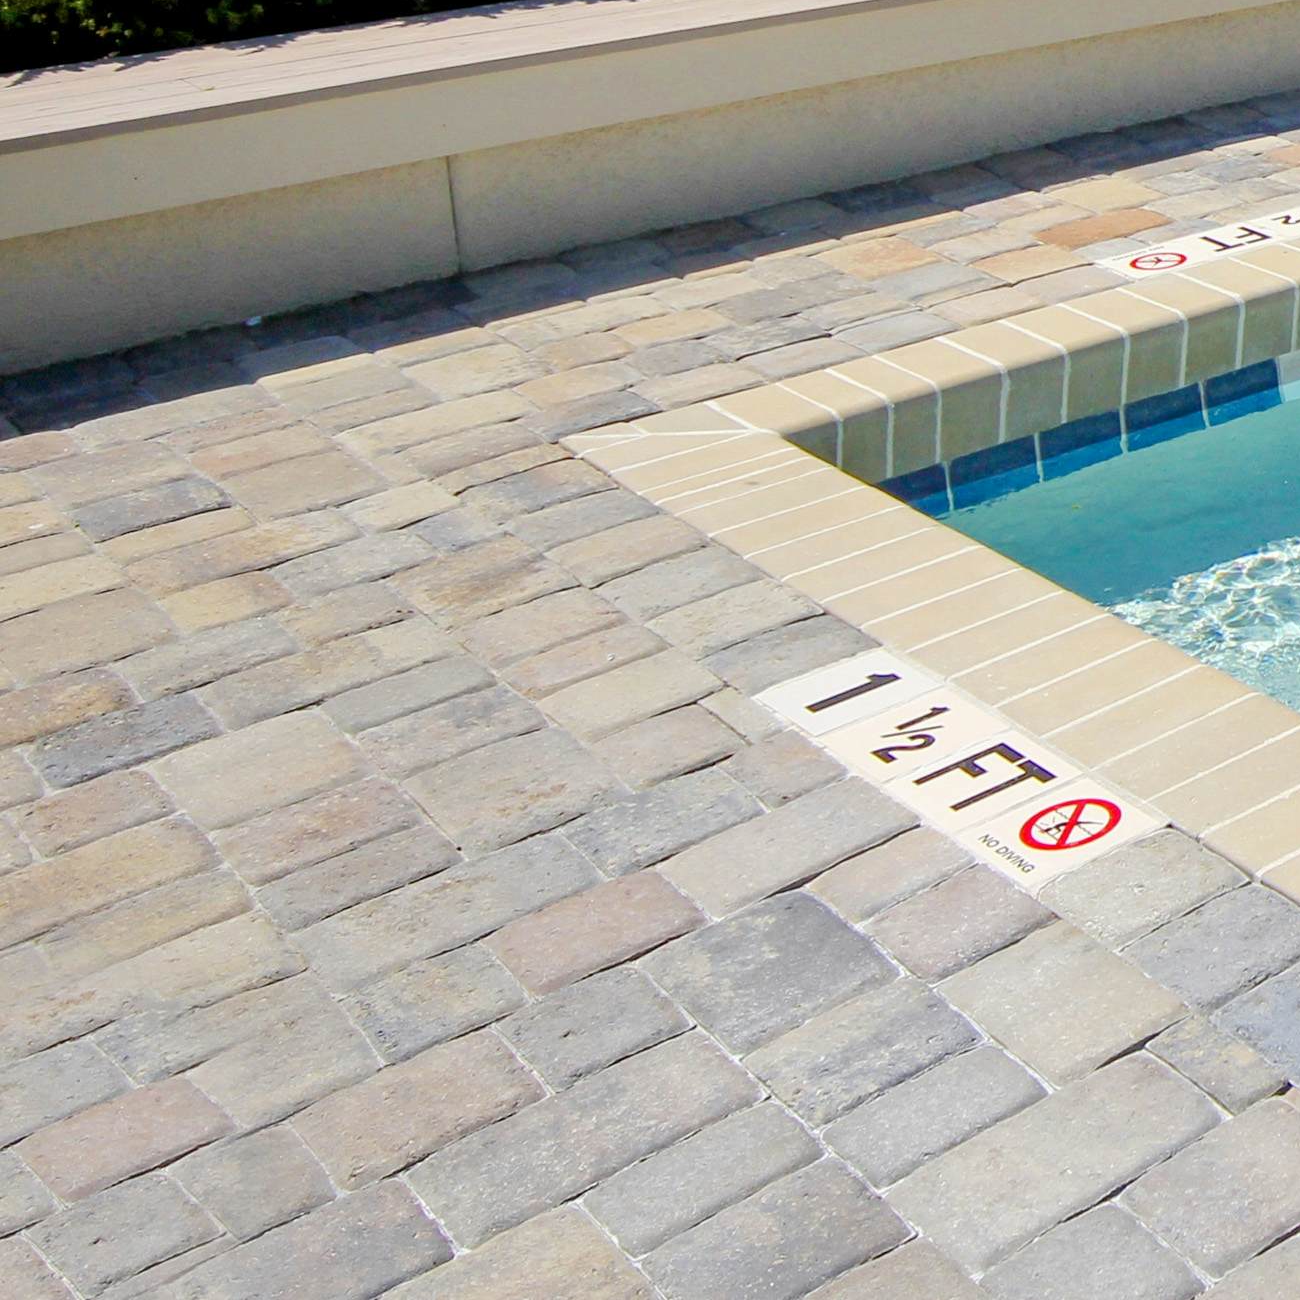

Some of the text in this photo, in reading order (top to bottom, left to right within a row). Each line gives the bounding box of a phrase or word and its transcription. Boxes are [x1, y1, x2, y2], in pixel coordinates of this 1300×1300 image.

[1199, 225, 1272, 253] FT
[805, 672, 902, 713] 1
[911, 742, 1058, 812] FT
[978, 833, 1036, 873] NO DIVING
